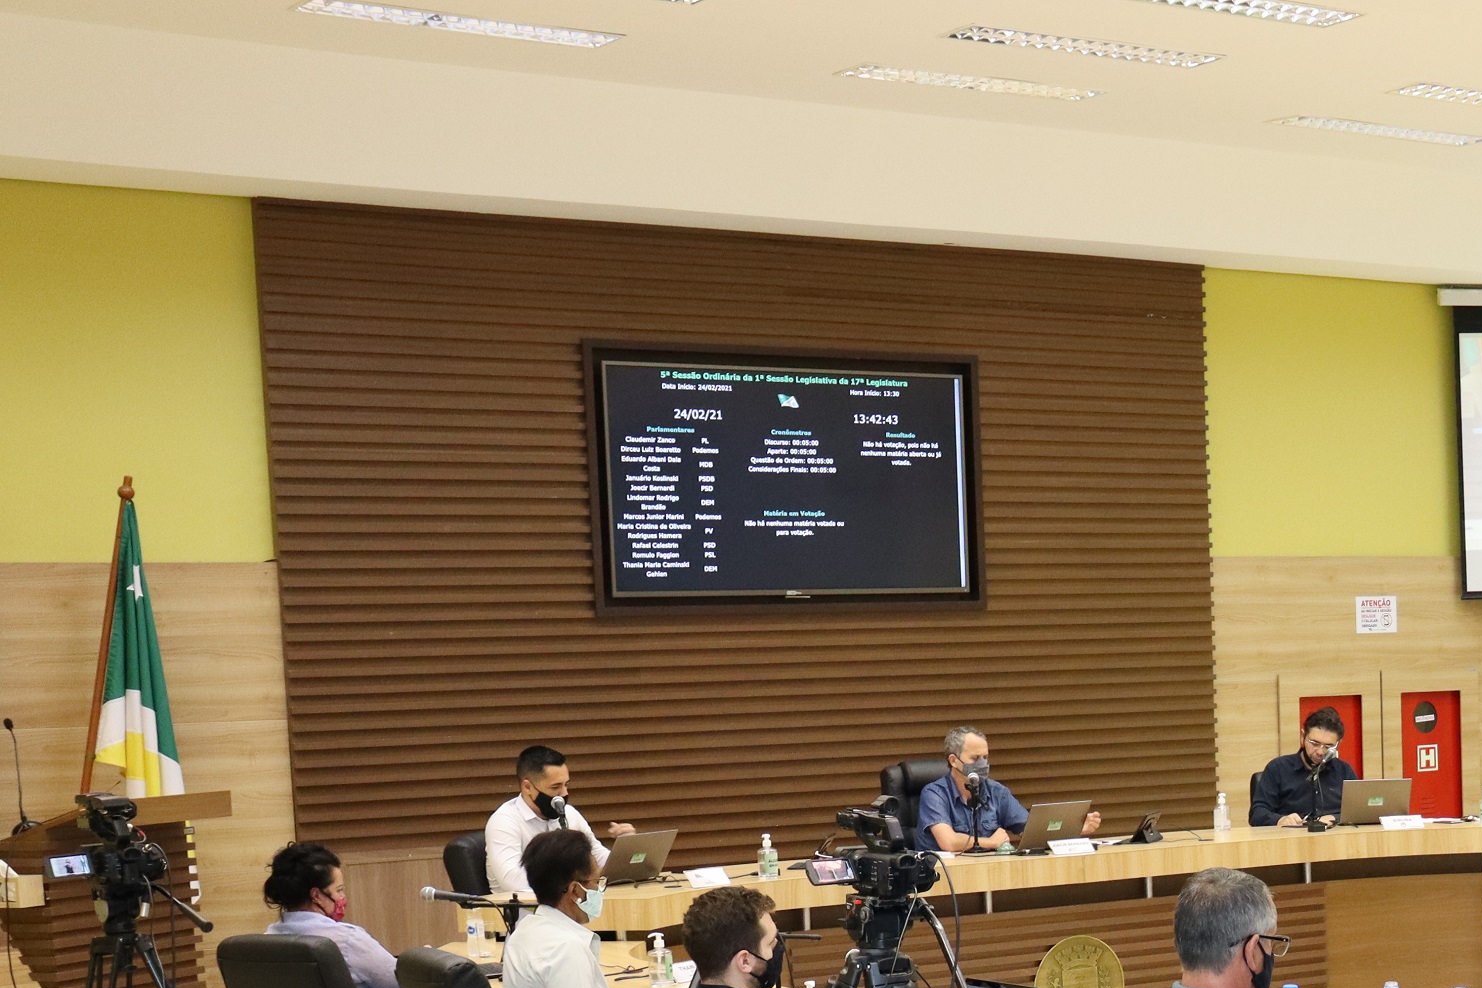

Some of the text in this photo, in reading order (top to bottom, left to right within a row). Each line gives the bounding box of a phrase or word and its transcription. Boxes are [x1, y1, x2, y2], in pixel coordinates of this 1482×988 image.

[661, 370, 670, 379] 5ª
[672, 371, 701, 380] Sessão
[703, 372, 741, 381] Ordinária
[755, 374, 764, 382] 1ª
[766, 374, 794, 383] Sessão
[796, 376, 837, 385] Legislativa
[851, 378, 864, 386] 17ª
[866, 379, 908, 388] Legislatura
[678, 383, 696, 391] Início:
[698, 384, 733, 392] 24/02/2021
[674, 409, 722, 421] 24/02/21
[853, 414, 898, 425] 13:42:43
[647, 426, 695, 434] Parlamentares
[908, 442, 919, 450] pois
[767, 448, 789, 456] Aparte:
[748, 466, 789, 474] Considerações
[800, 510, 826, 518] Votação
[791, 529, 814, 537] votação.
[656, 552, 680, 560] Faggion
[1361, 598, 1391, 609] ATENÇÃO
[1421, 748, 1435, 768] H
